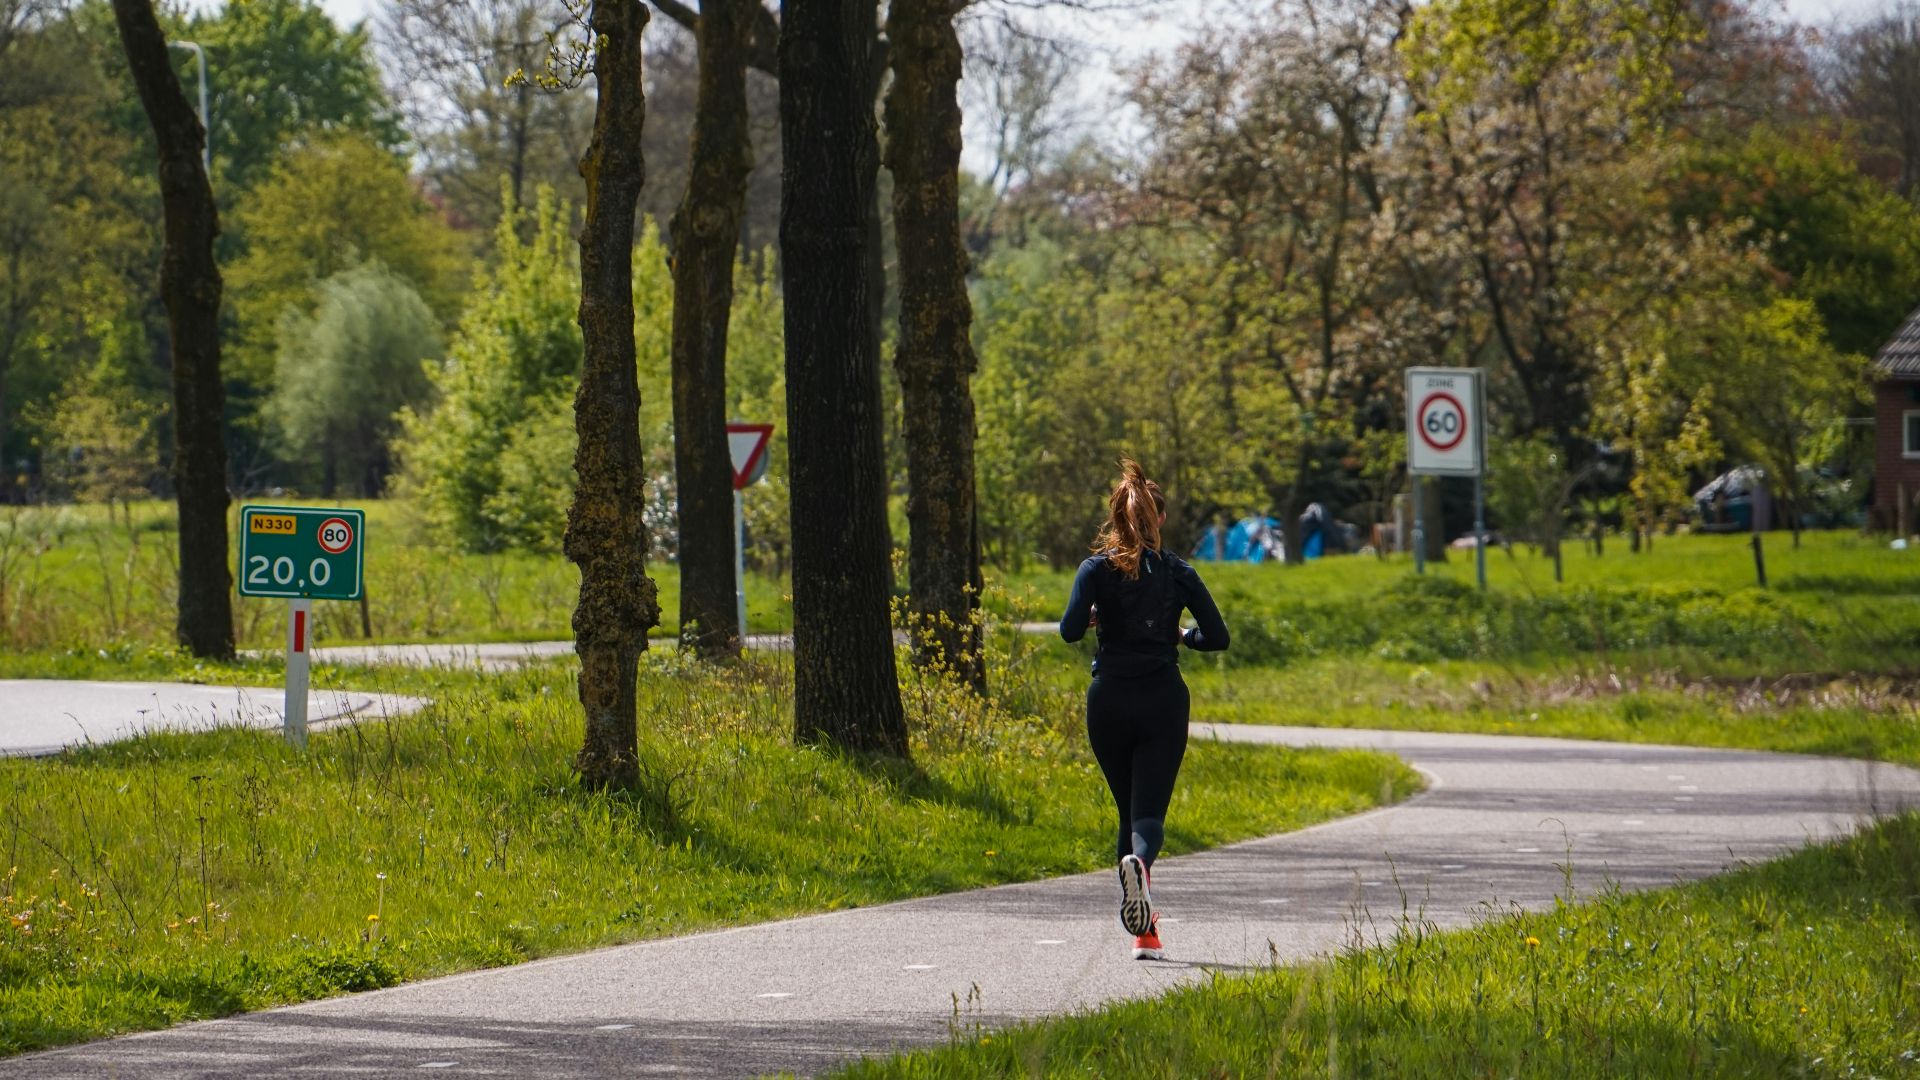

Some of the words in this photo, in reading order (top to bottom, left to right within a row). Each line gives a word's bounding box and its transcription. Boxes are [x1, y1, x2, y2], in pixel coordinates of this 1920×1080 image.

[1427, 411, 1457, 433] 60
[254, 519, 293, 530] N330
[324, 529, 347, 542] 80
[248, 555, 331, 588] 20,0
